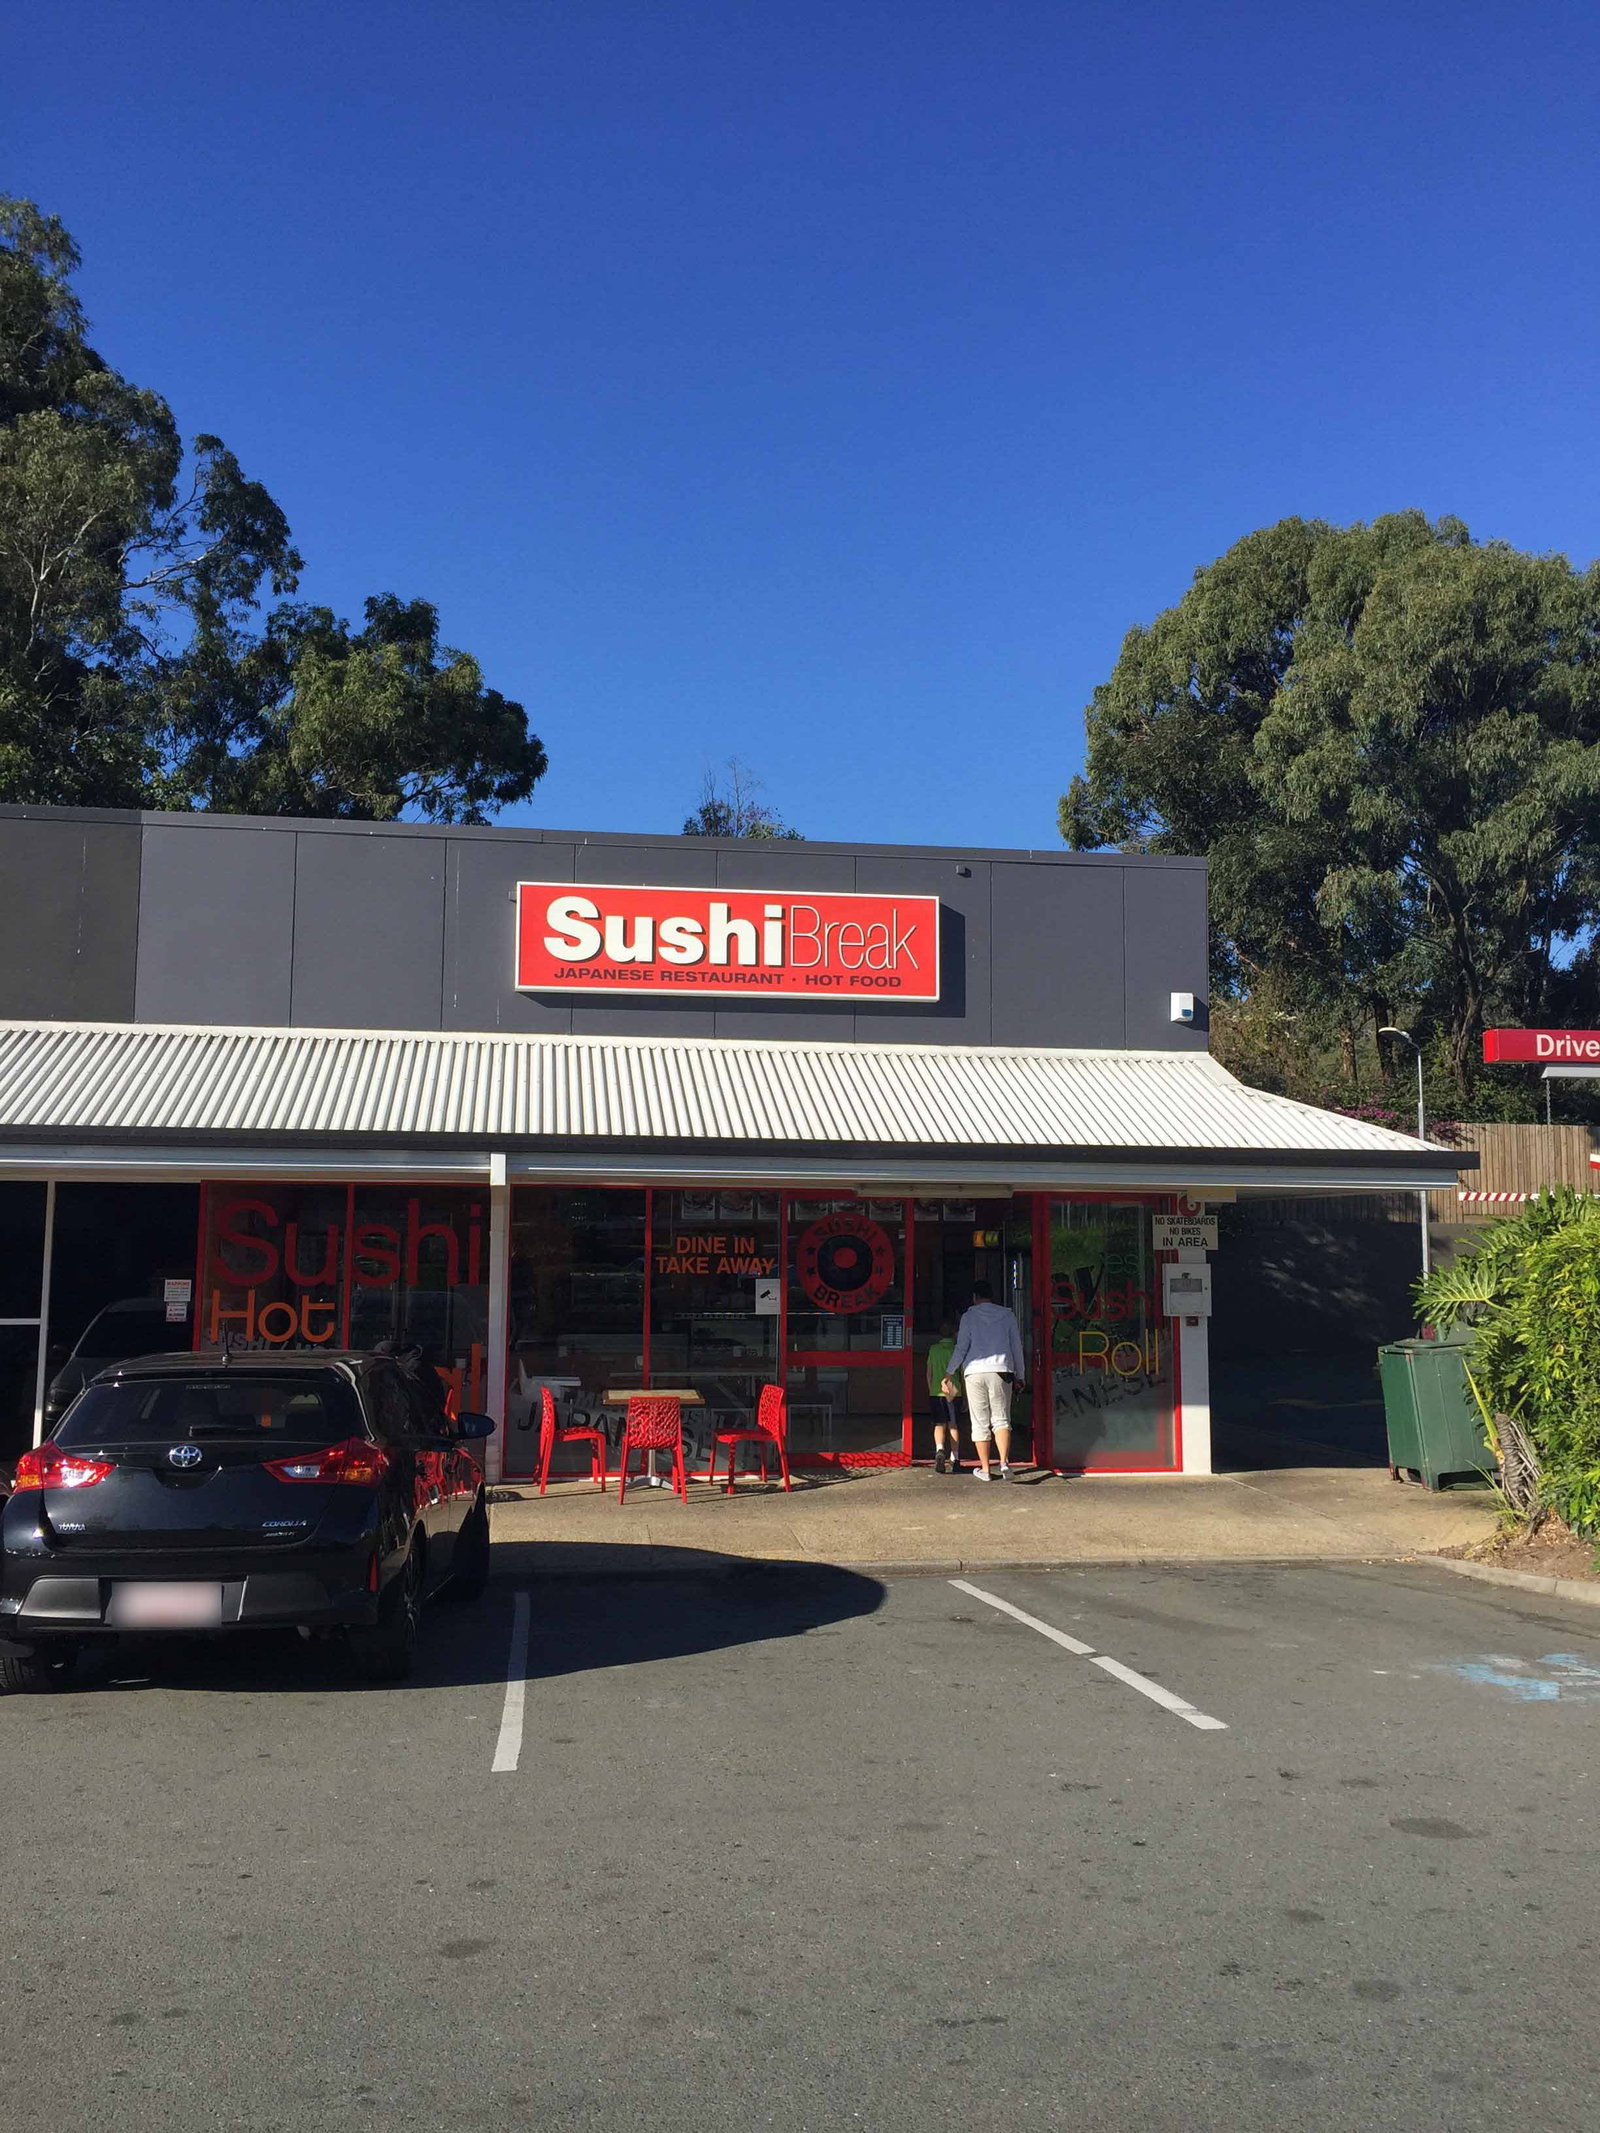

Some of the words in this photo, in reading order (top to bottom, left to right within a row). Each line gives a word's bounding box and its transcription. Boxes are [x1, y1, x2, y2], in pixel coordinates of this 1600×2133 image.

[554, 967, 654, 981] JAPANESE
[660, 970, 783, 984] RESTAURANT
[805, 975, 843, 986] HOT
[849, 975, 902, 988] FOOD
[1536, 1034, 1600, 1057] Drive
[1155, 1216, 1165, 1226] NO
[1166, 1216, 1216, 1226] SKATEBOARDS
[1169, 1227, 1180, 1236] NO
[1181, 1227, 1201, 1236] BIKES
[216, 1199, 481, 1287] Sushi
[676, 1236, 726, 1254] DINE
[734, 1237, 755, 1254] IN
[1162, 1237, 1174, 1247] IN
[1177, 1237, 1209, 1248] AREA
[656, 1256, 710, 1275] TAKE
[716, 1256, 776, 1275] AWAY
[813, 1280, 882, 1309] BREAK
[210, 1289, 336, 1343] Hot
[1078, 1328, 1160, 1376] Roll
[58, 1522, 86, 1531] TOYOTA
[262, 1519, 308, 1527] COROLLA
